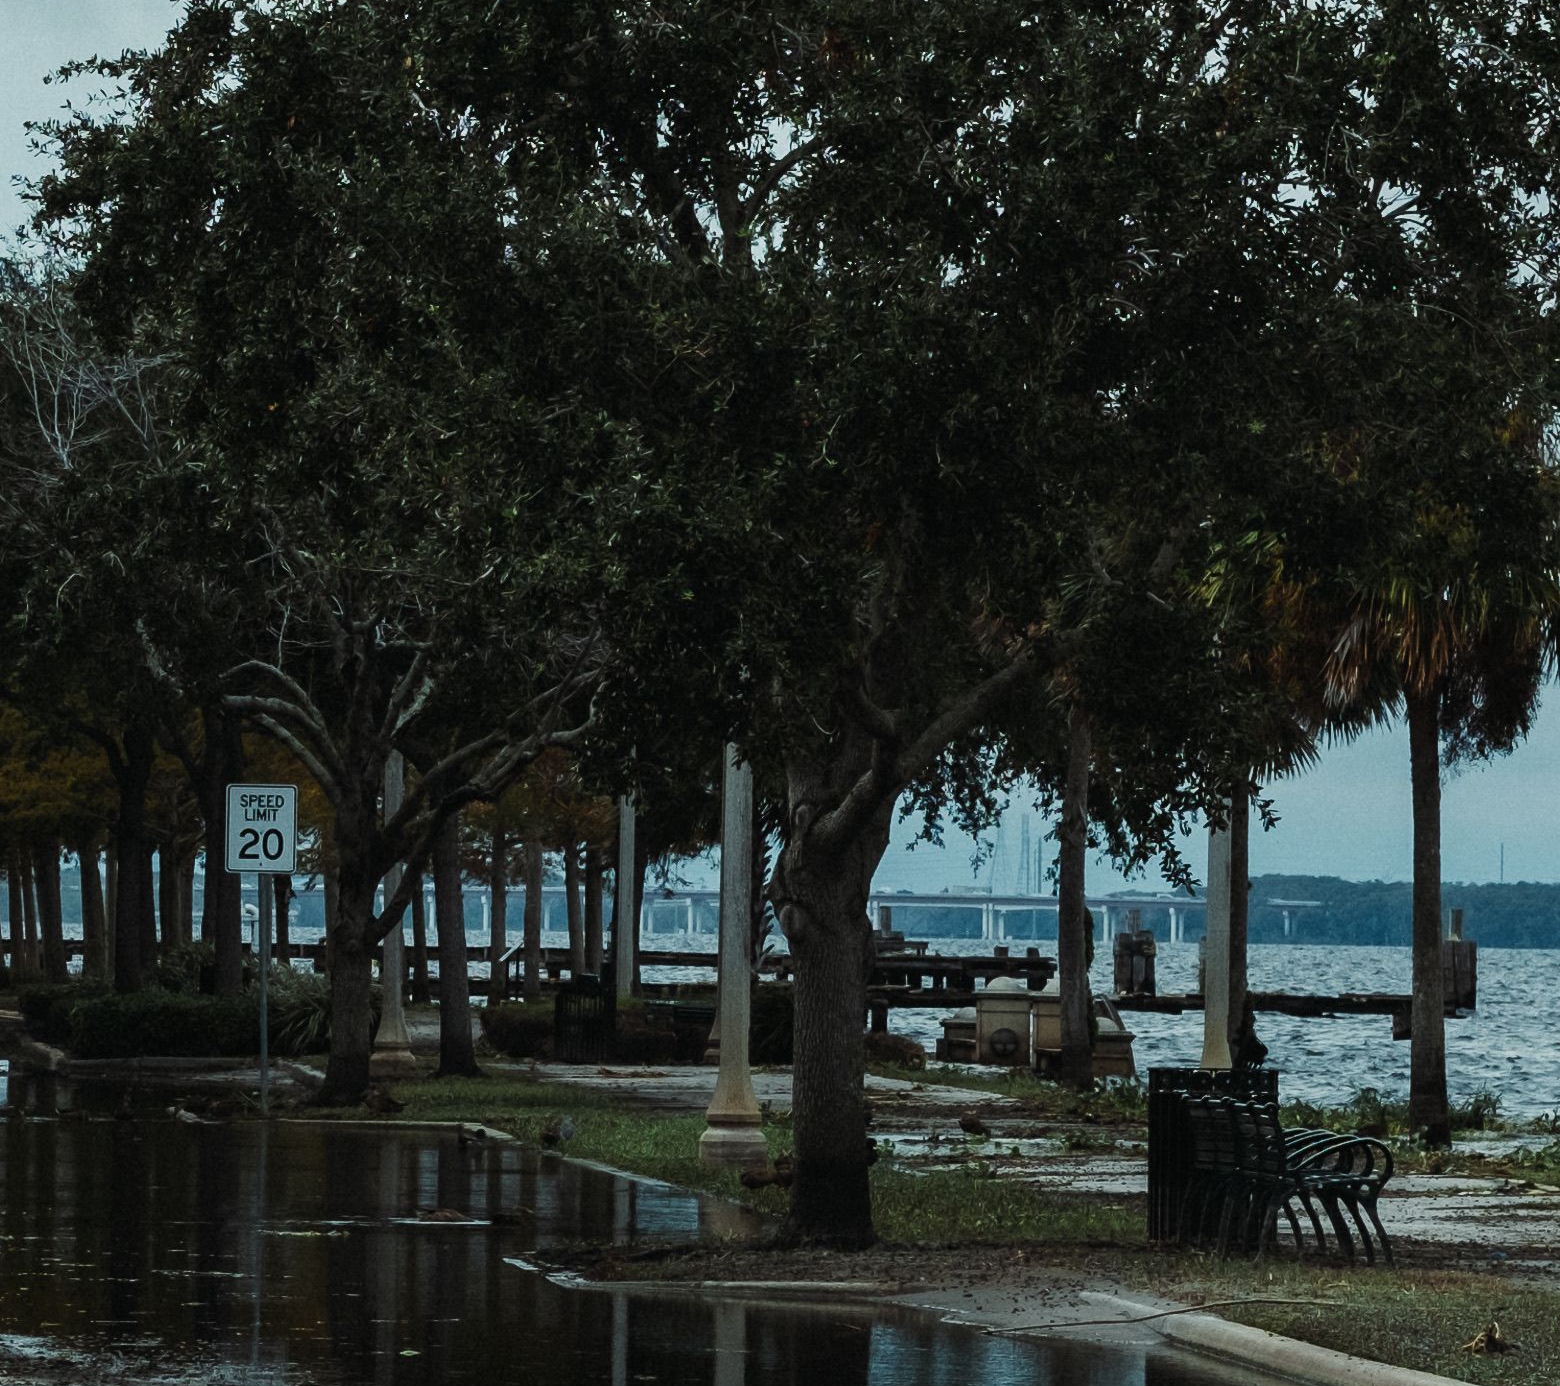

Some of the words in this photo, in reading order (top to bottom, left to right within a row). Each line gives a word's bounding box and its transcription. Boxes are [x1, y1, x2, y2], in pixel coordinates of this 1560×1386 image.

[241, 794, 284, 808] SPEED
[244, 809, 278, 822] LIMIT
[239, 828, 284, 860] 20
